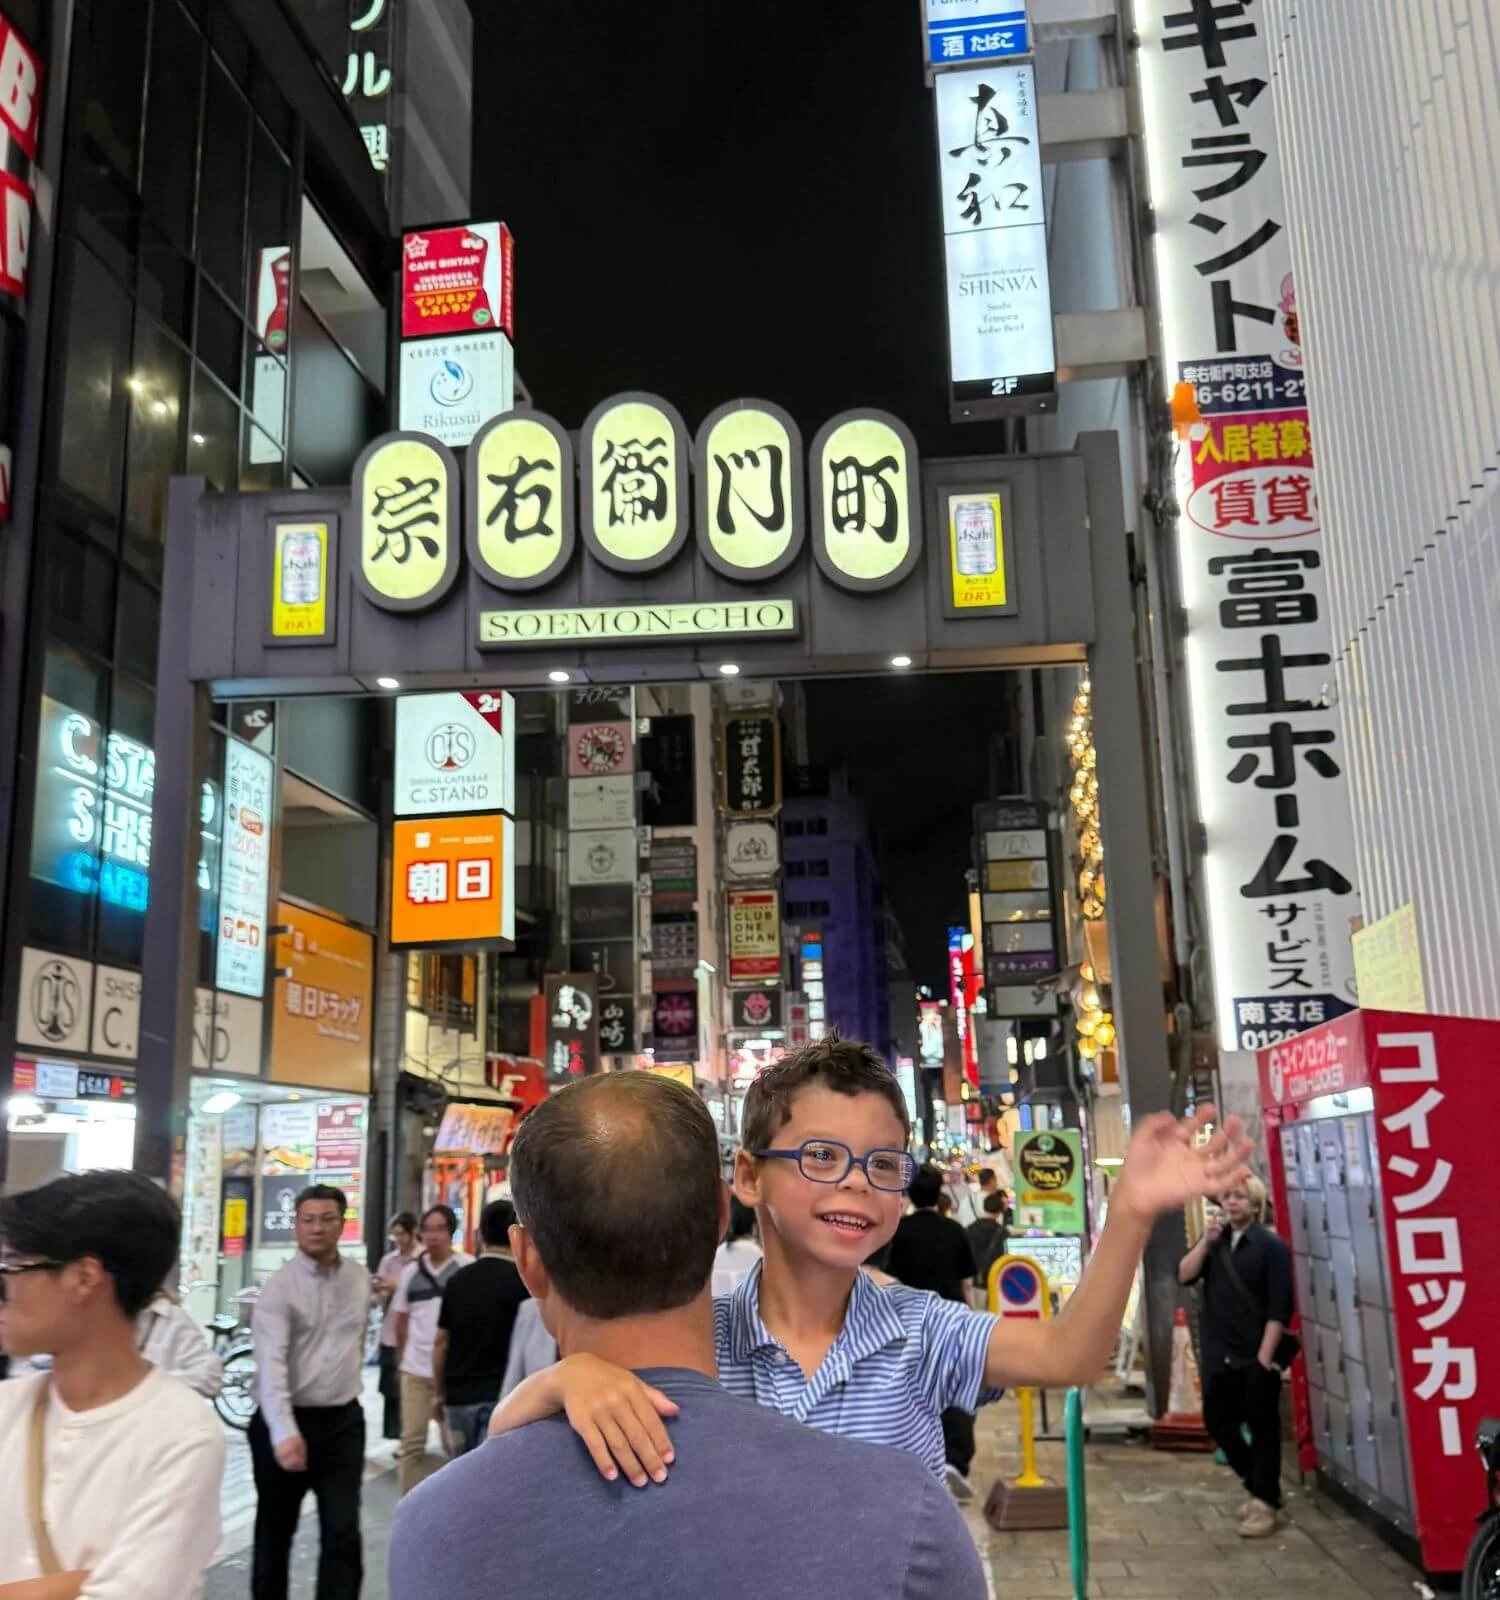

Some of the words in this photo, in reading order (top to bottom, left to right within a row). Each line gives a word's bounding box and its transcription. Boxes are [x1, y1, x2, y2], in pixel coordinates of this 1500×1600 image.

[942, 34, 965, 57] 酒
[970, 31, 1015, 53] たばこ
[408, 259, 437, 272] CAFE
[959, 275, 1038, 297] SHINWA
[991, 377, 1018, 396] 2F
[1193, 380, 1307, 405] 6-6211-2
[423, 410, 481, 429] Rikusui
[1195, 419, 1312, 465] 入居者募
[371, 437, 899, 563] 宗右衛門町
[488, 603, 785, 639] SOEMON-CHO
[1208, 548, 1352, 898] 富士ホーム
[410, 785, 489, 804] C.STAND
[407, 859, 491, 903] 朝日
[735, 911, 773, 921] CLUB
[735, 922, 763, 934] ONE
[735, 933, 776, 944] CHAN
[1259, 902, 1314, 990] サービス
[1238, 1000, 1325, 1025] 南支店
[1377, 1031, 1477, 1456] コインロッカー
